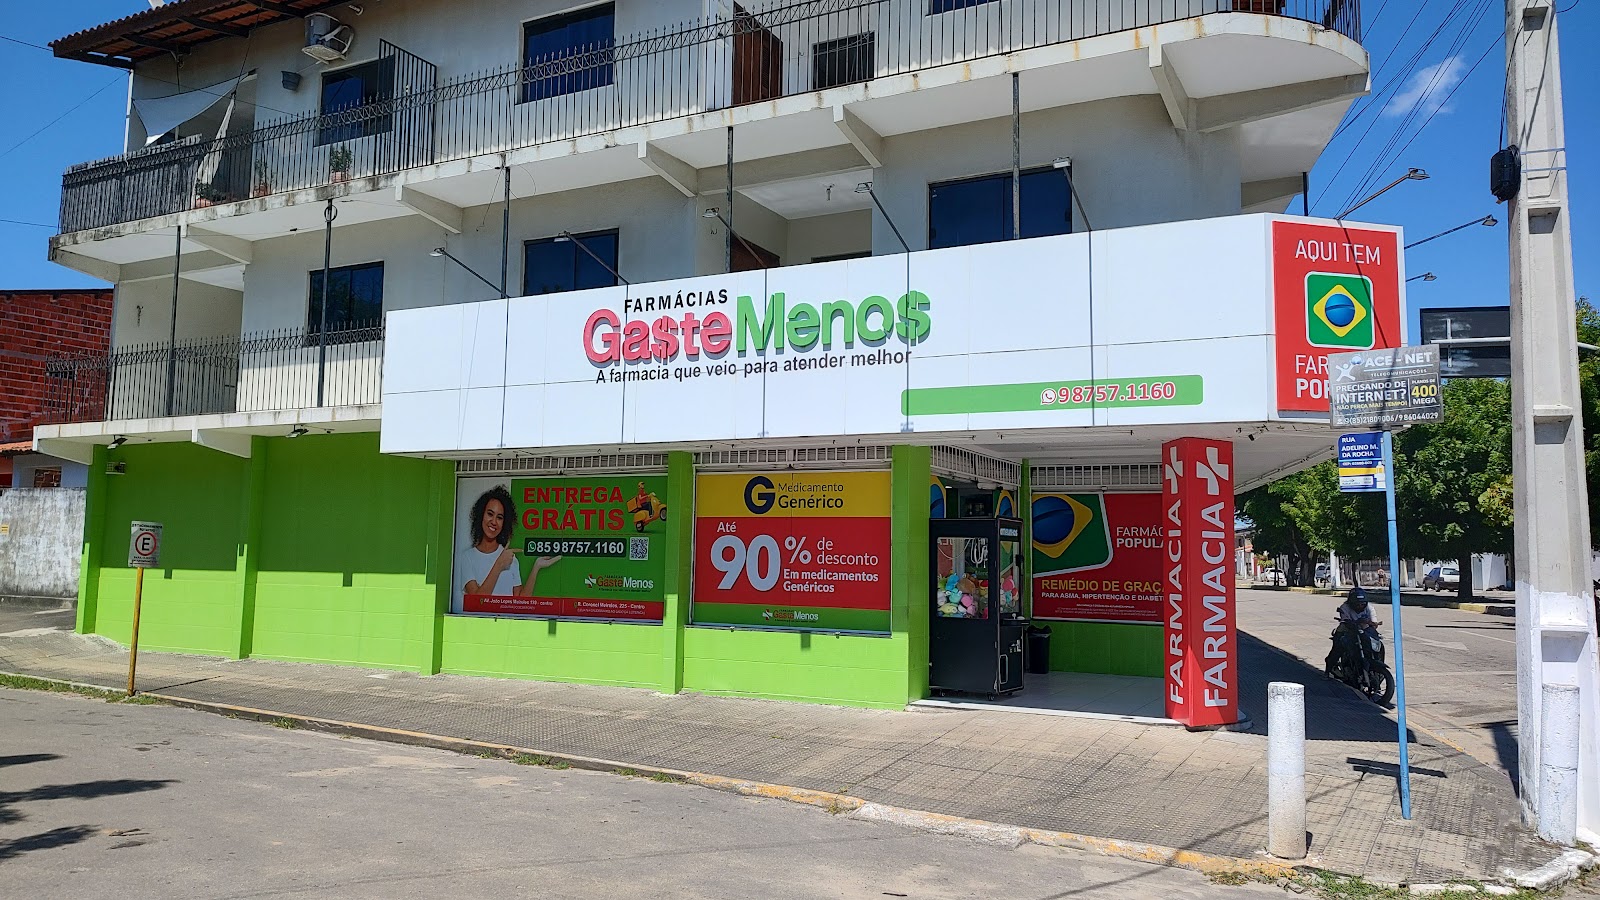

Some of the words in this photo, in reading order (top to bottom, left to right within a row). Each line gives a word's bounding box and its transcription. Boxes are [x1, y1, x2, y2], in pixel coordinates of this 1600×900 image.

[1295, 240, 1337, 262] AQUI
[1342, 242, 1381, 266] TEM
[624, 288, 728, 313] FARMÁCIAS
[596, 369, 606, 384] A
[609, 366, 669, 382] farmacia
[674, 366, 701, 382] que
[706, 360, 737, 377] veio
[744, 361, 778, 378] para
[783, 353, 846, 371] atender
[851, 349, 912, 367] melhor
[1365, 354, 1393, 367] ACE
[1404, 352, 1432, 364] NET
[1336, 381, 1392, 393] PRECISANDO
[1394, 380, 1406, 388] DE
[1411, 384, 1437, 398] 400
[1336, 388, 1407, 404] INTERNET?
[1412, 397, 1437, 405] MEGA
[744, 475, 776, 514] G
[778, 482, 844, 492] Medicamento
[523, 487, 623, 503] ENTREGA
[778, 494, 844, 509] Genérico
[522, 504, 625, 530] GRÁTIS
[716, 521, 736, 533] Até
[141, 537, 151, 551] E
[816, 537, 833, 550] de
[816, 551, 878, 566] desconto
[783, 568, 799, 580] Em
[801, 569, 879, 582] medicamentos
[783, 581, 835, 593] Genéricos
[1041, 578, 1099, 592] REMÉDIO
[1103, 581, 1120, 592] DE
[1123, 581, 1164, 595] GRAÇ
[1167, 499, 1184, 705] FARMACIA
[1201, 501, 1228, 707] FARMACIA
